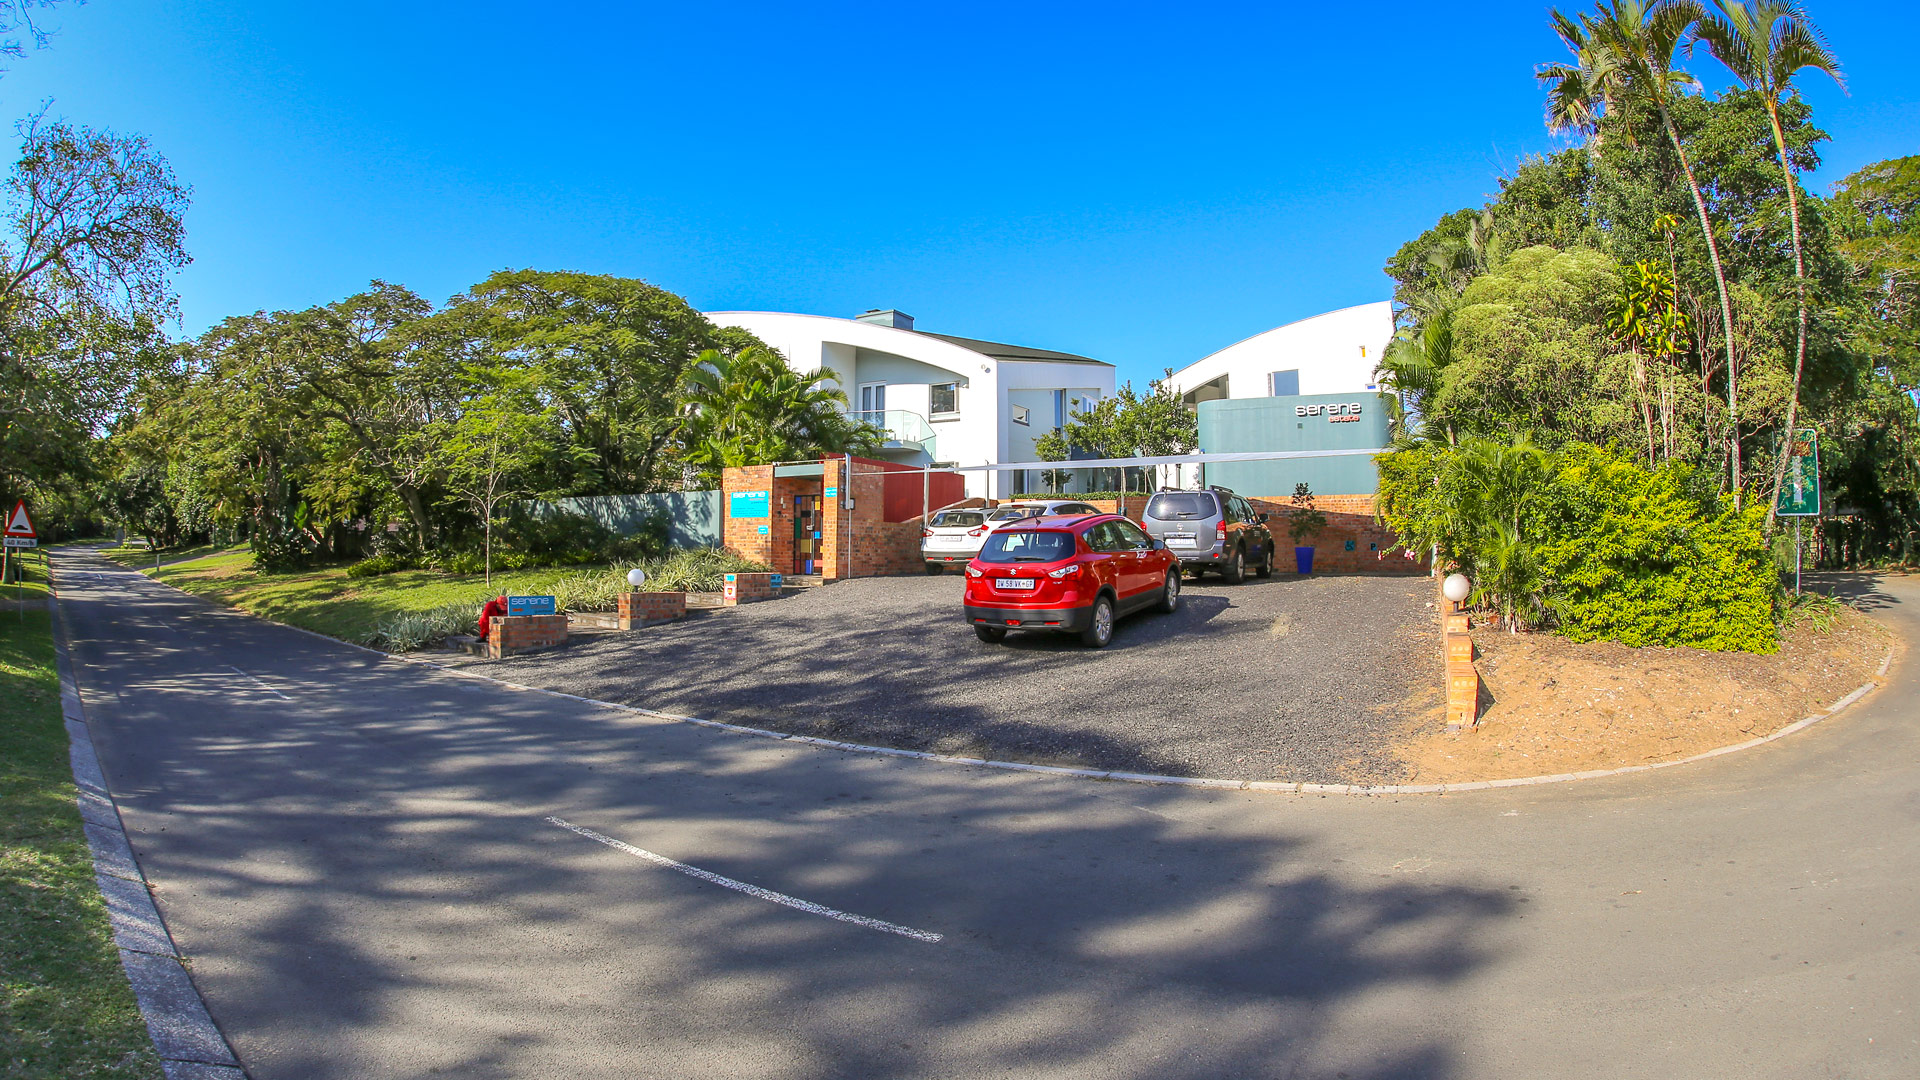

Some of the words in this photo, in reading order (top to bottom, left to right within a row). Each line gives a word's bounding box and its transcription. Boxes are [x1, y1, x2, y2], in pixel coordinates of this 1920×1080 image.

[1295, 402, 1361, 416] serene
[1328, 415, 1360, 423] estate
[511, 597, 549, 605] serene
